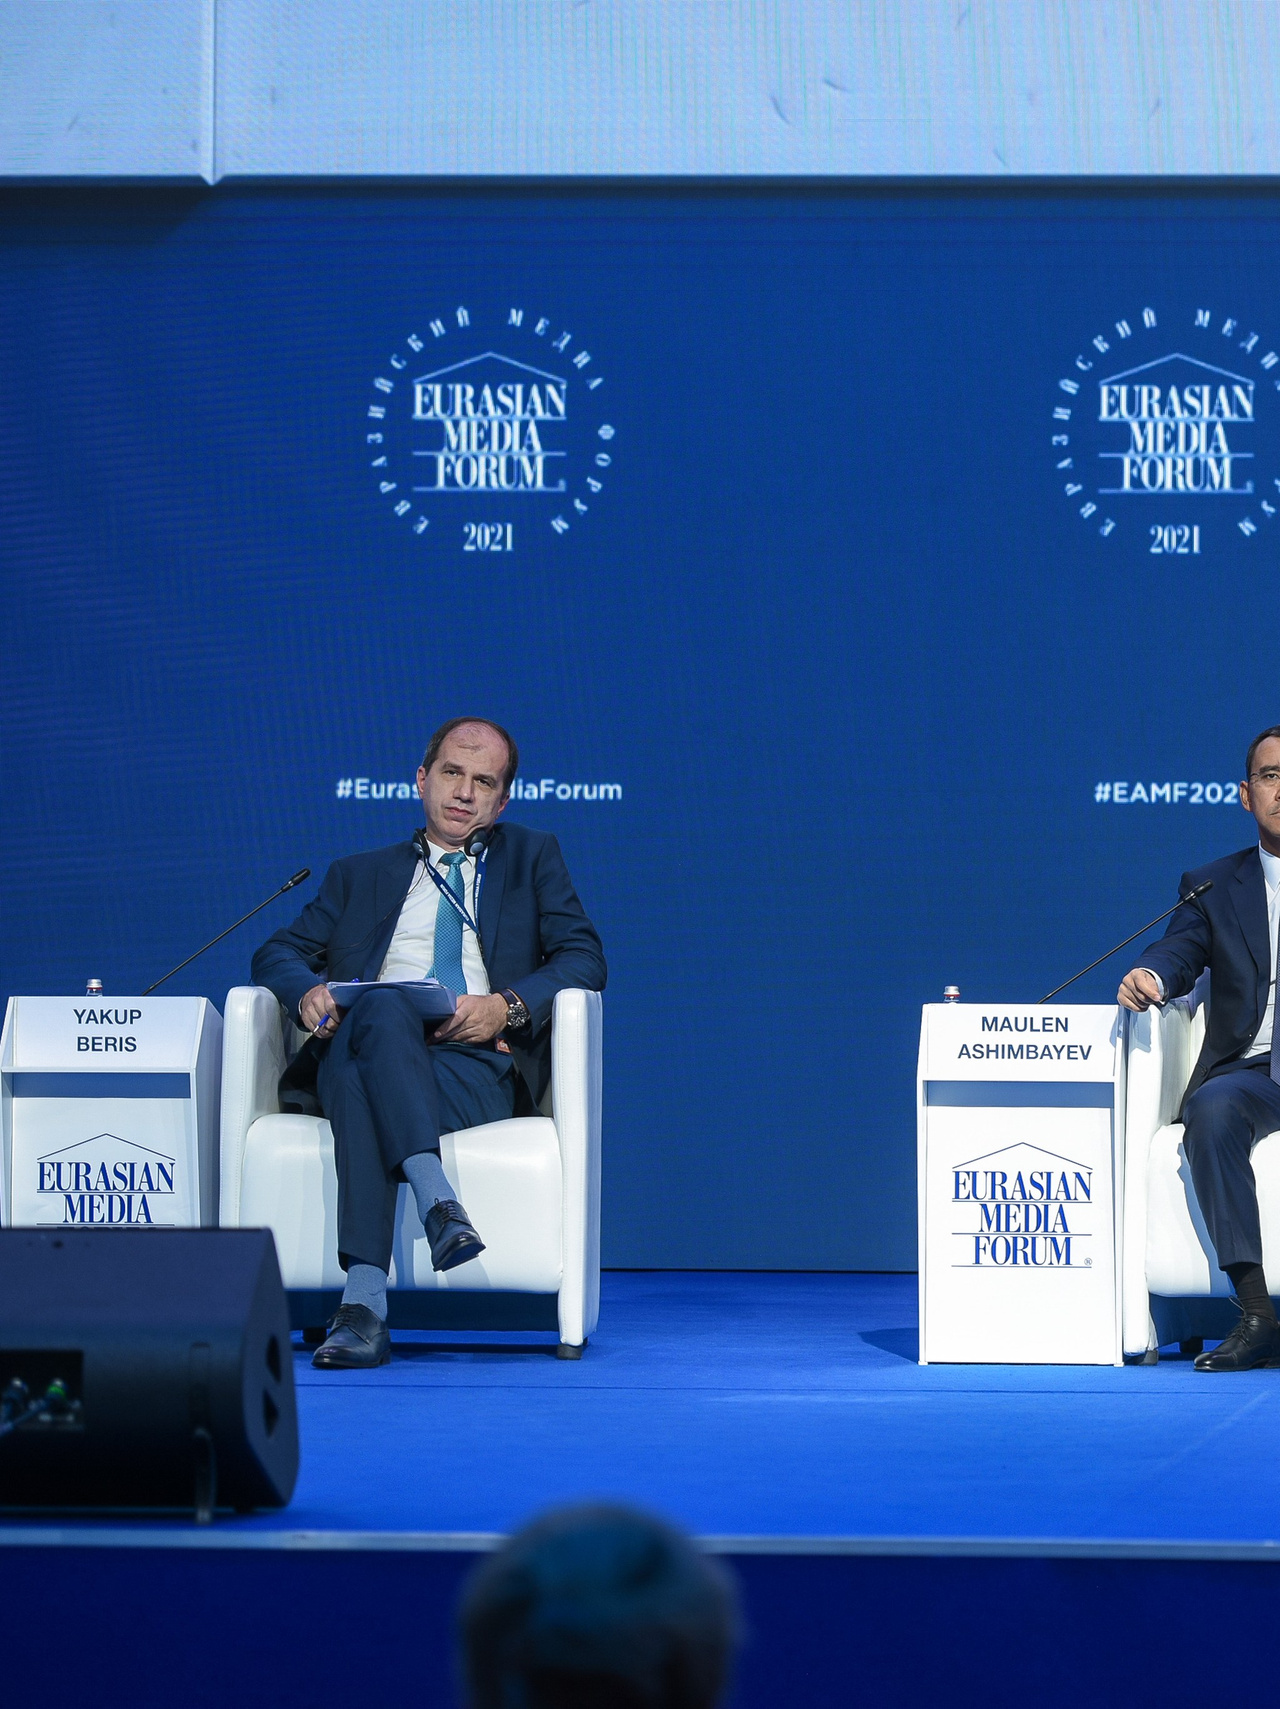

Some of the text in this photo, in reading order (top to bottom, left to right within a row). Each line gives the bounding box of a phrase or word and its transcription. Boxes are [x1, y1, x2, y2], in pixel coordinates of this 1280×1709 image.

[413, 383, 566, 419] EURASIAN
[1100, 385, 1254, 420] EURASIAN
[443, 419, 542, 453] MEDIA
[1129, 420, 1229, 455] MEDIA
[434, 453, 544, 489] FORUM
[1122, 455, 1232, 491] FORUM
[463, 522, 514, 551] 2021
[1149, 525, 1200, 553] 2021
[1095, 782, 1240, 804] #EAMF202
[73, 1009, 142, 1025] YAKUP
[981, 1016, 1069, 1033] MAULEN
[77, 1036, 137, 1052] BERIS
[958, 1044, 1092, 1060] ASHIMBAYEV
[37, 1162, 175, 1191] EURASIAN
[952, 1171, 1092, 1201] EURASIAN
[63, 1194, 153, 1223] MEDIA
[978, 1203, 1070, 1233] MEDIA
[972, 1236, 1073, 1265] FORUM
